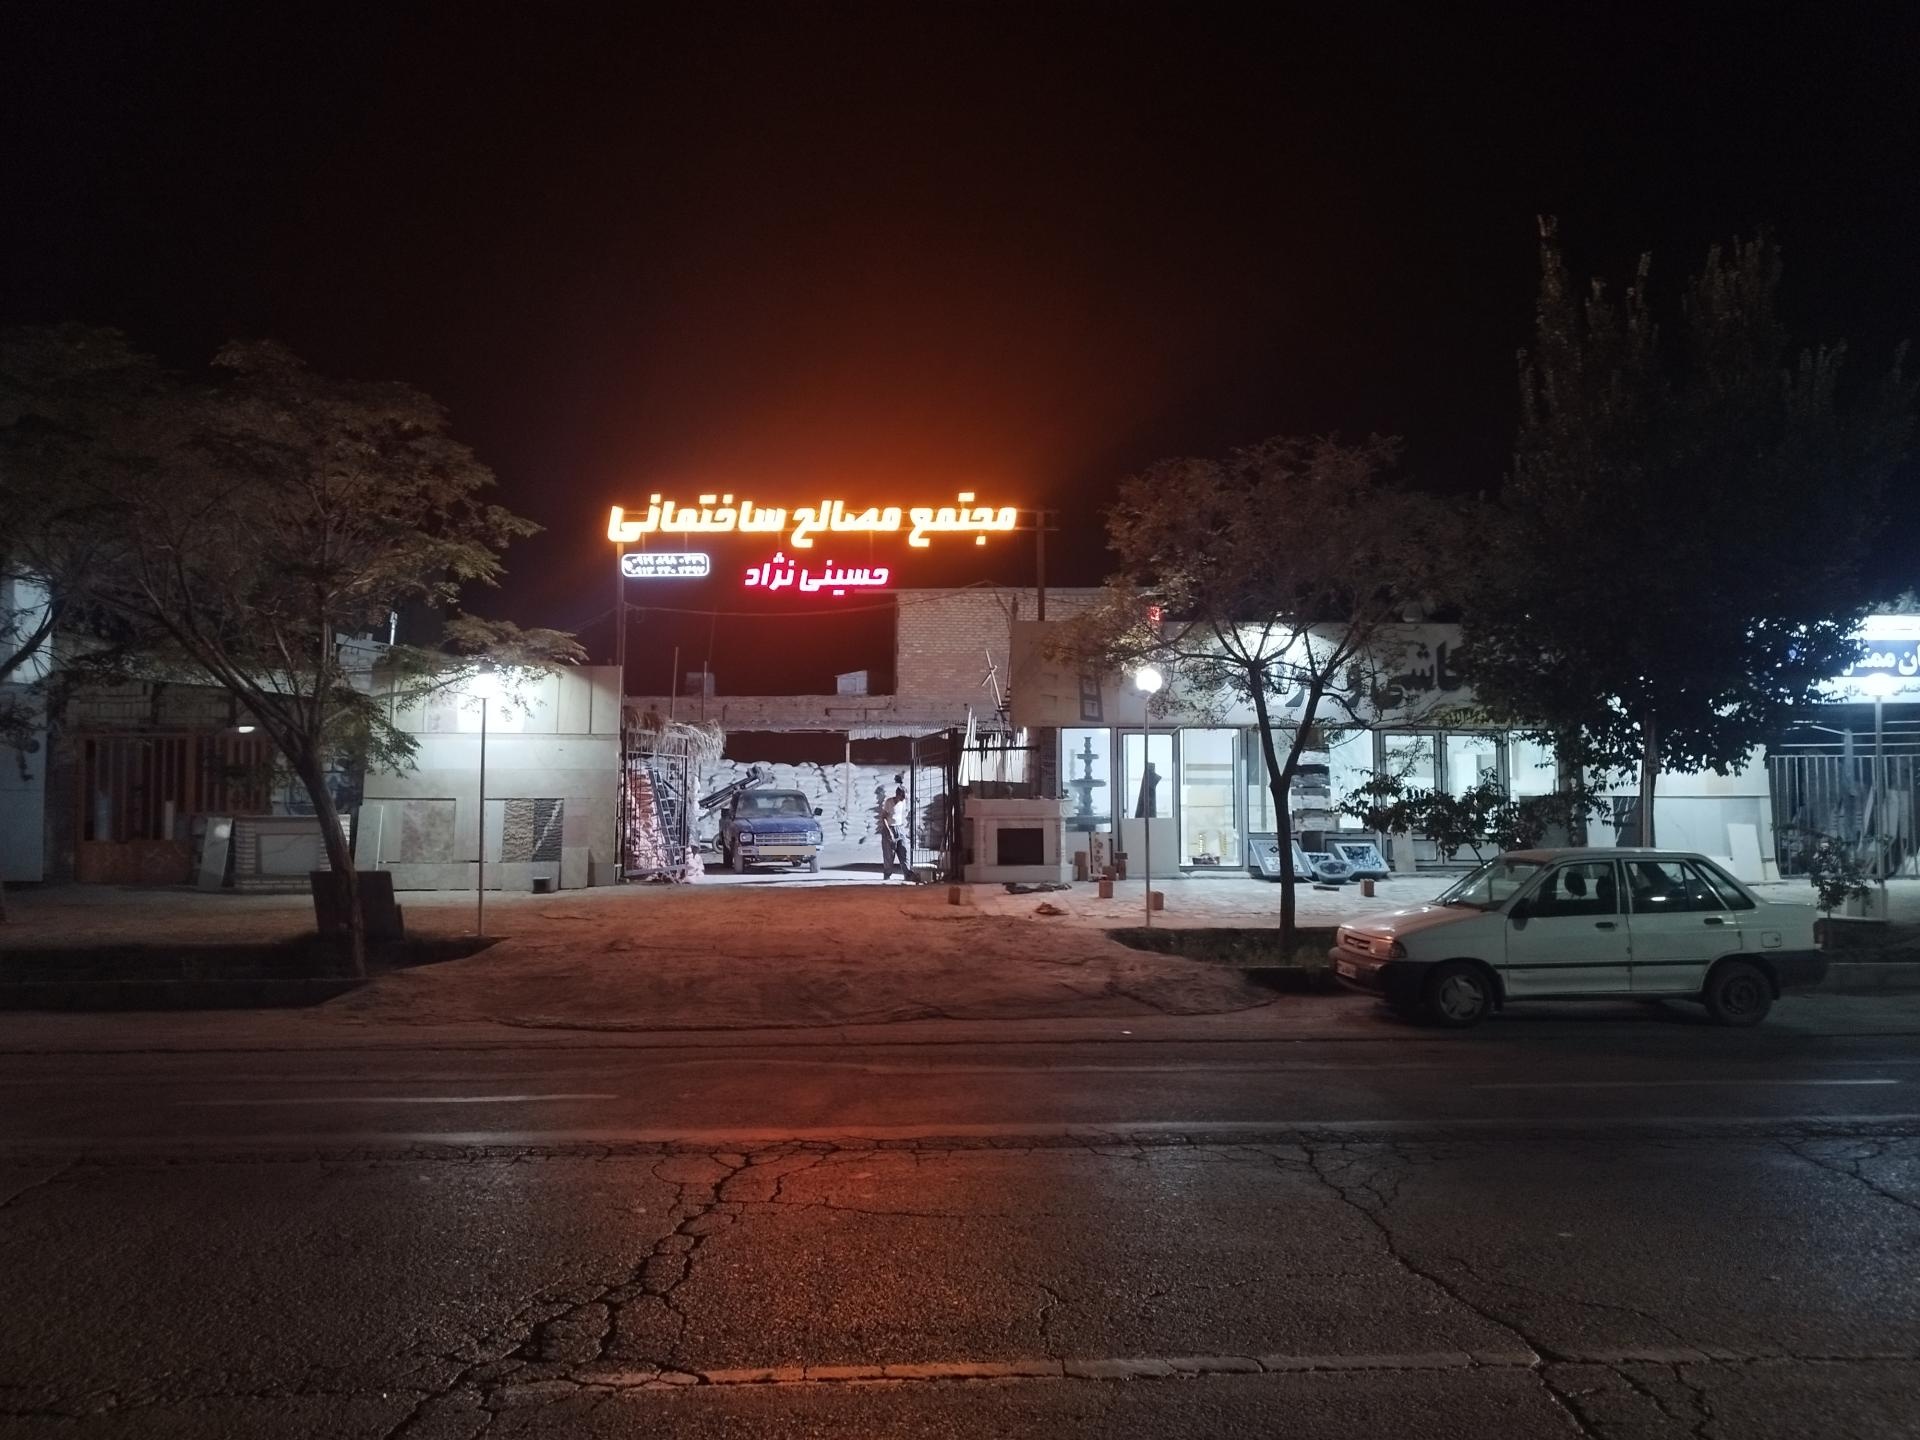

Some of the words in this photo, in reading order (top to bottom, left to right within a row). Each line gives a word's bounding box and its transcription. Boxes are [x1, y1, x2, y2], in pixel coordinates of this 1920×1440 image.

[607, 494, 787, 542] ساختمانی
[791, 500, 902, 548] مصالح
[908, 492, 1017, 548] مجتمع
[745, 552, 795, 590] نژاد
[800, 560, 889, 595] حسینی
